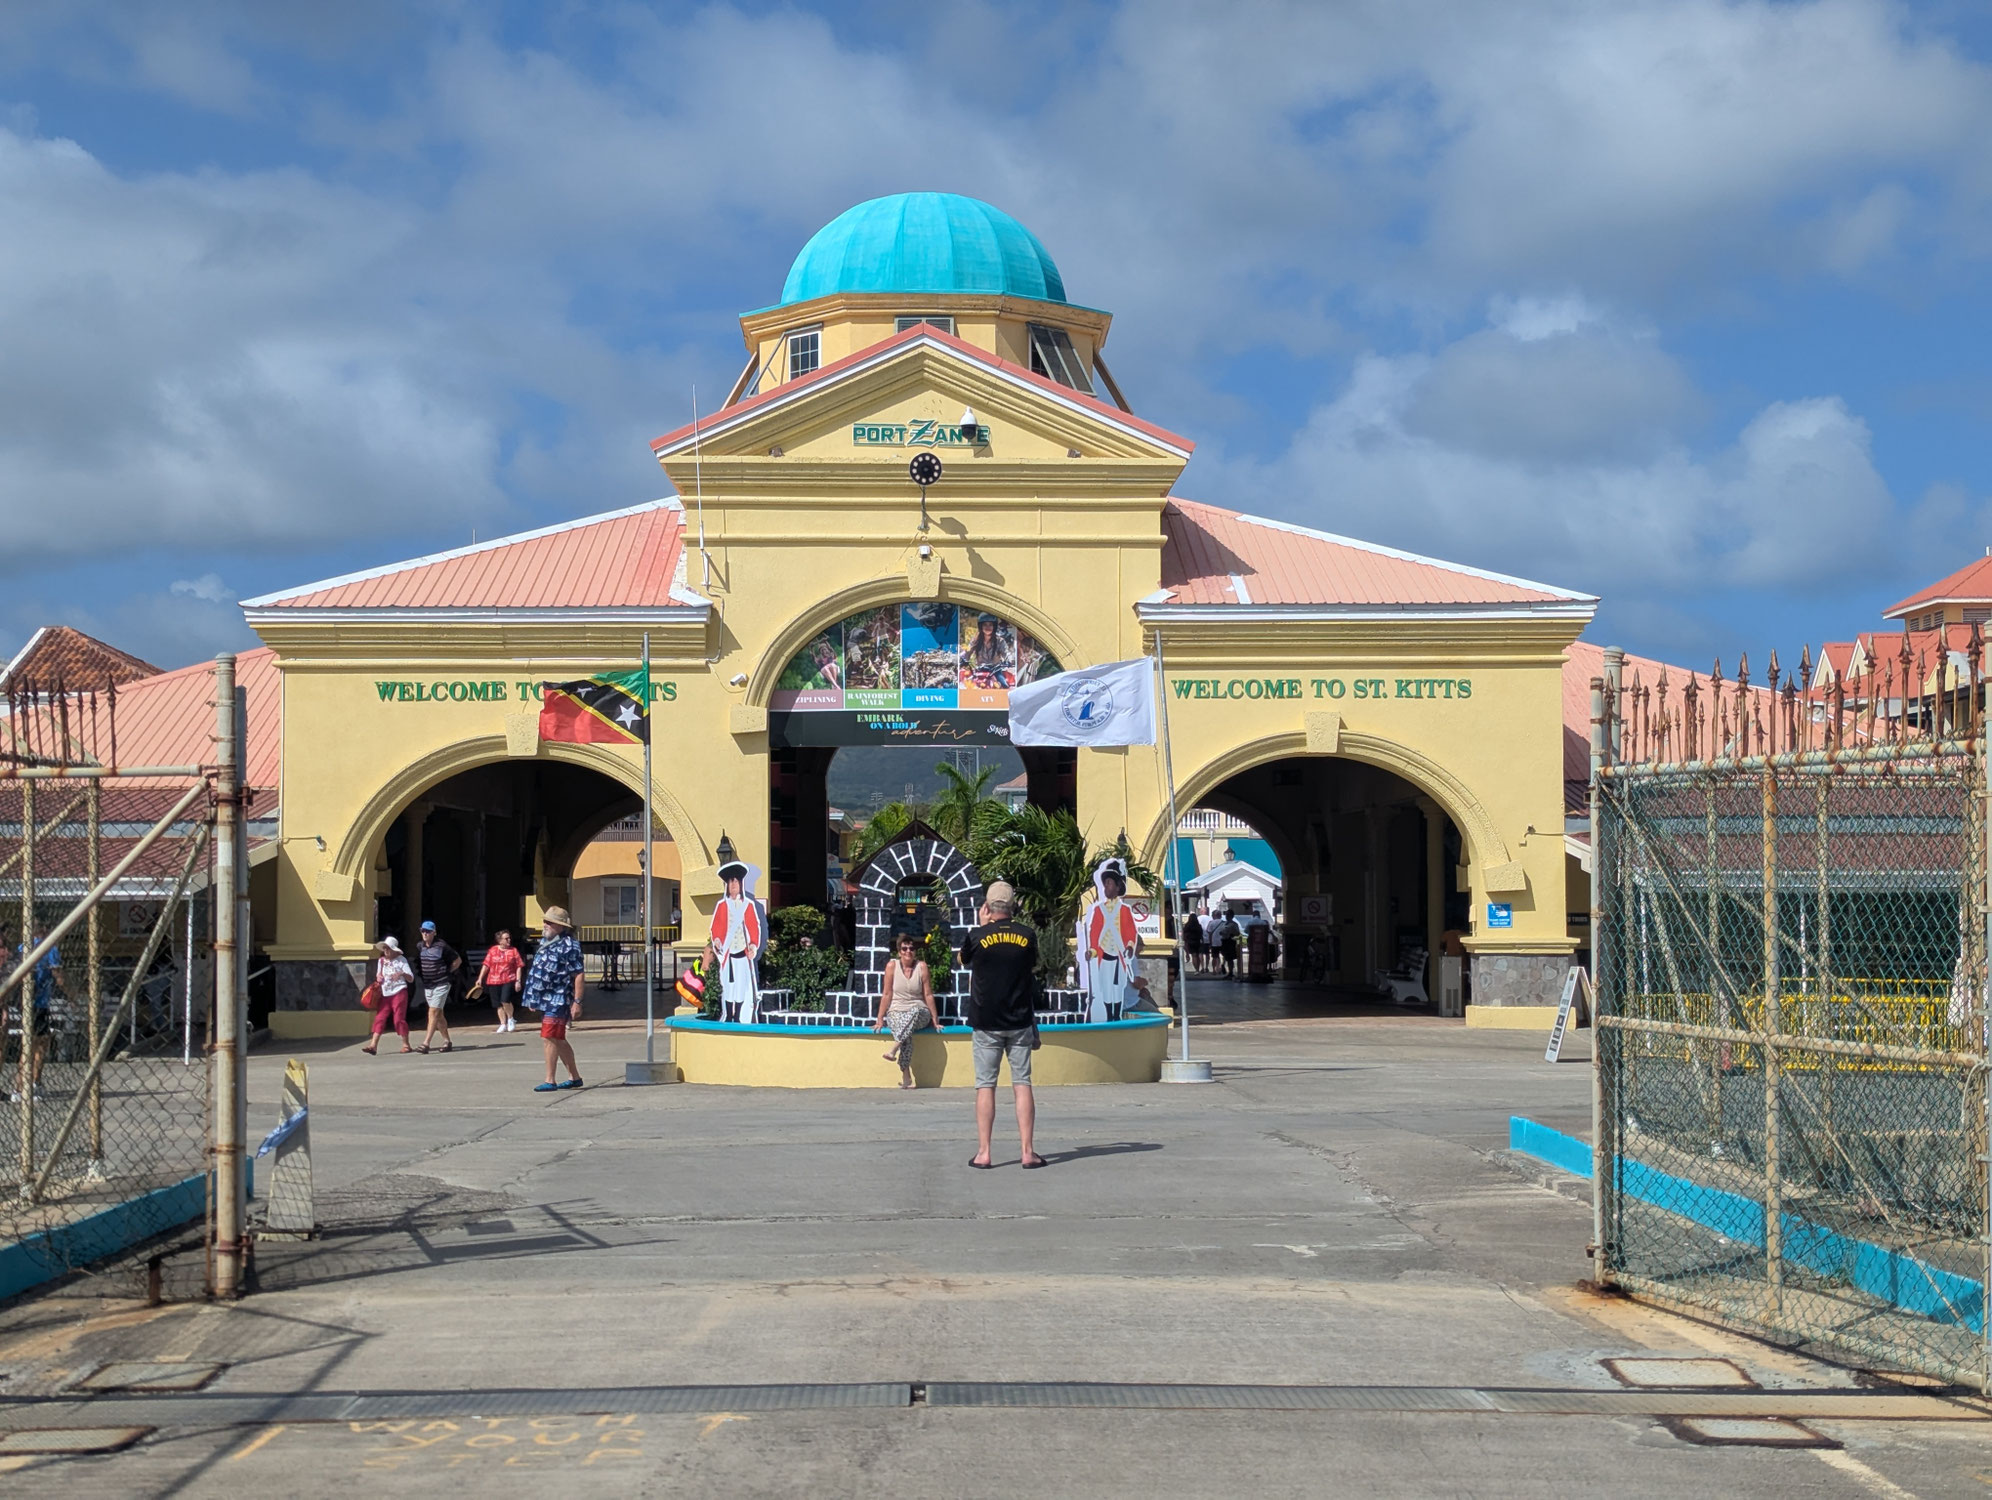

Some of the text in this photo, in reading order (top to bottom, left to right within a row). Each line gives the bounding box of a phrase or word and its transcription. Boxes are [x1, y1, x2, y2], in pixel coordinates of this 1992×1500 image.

[853, 419, 990, 448] PORT ZANE
[375, 681, 507, 701] WELCOME
[847, 692, 898, 700] RAINFOREST
[1172, 679, 1472, 699] WELCOME TO ST. KITTS
[795, 696, 837, 704] ZIPLINING
[856, 714, 904, 723] EMBARK
[869, 722, 883, 730] ON
[890, 719, 977, 740] adventure
[980, 932, 1029, 949] DORTMUND
[349, 1413, 639, 1433] WATCH
[367, 1429, 646, 1452] YOUR
